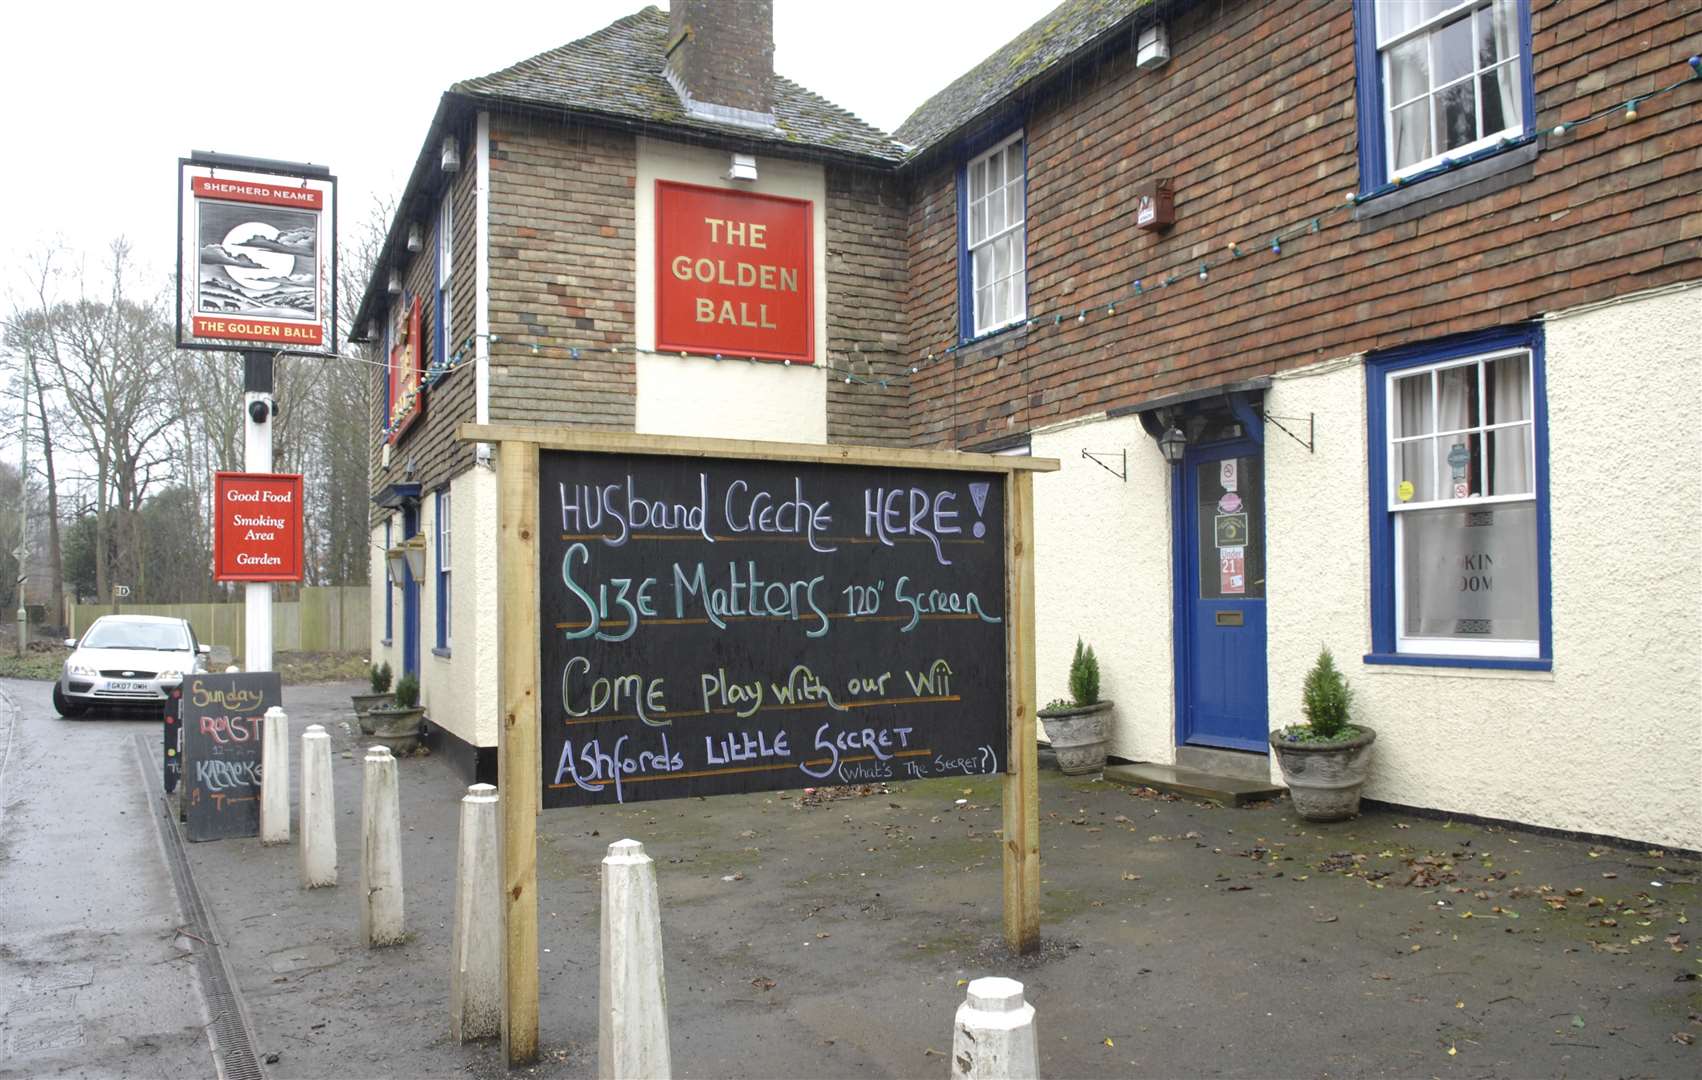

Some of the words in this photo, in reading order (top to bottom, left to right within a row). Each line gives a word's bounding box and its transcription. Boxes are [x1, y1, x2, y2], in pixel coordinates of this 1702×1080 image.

[203, 182, 270, 197] SHEPHERD
[273, 190, 315, 202] NEAME
[704, 217, 767, 249] THE
[671, 255, 798, 292] GOLDEN
[695, 297, 777, 330] BALL
[199, 321, 225, 333] THE
[228, 322, 280, 337] GOLDEN
[284, 327, 317, 339] BALL
[227, 489, 260, 502] Good
[262, 490, 292, 503] Food
[233, 514, 286, 529] Smoking
[244, 529, 275, 541] Area
[236, 552, 282, 565] Garden
[1222, 559, 1236, 573] 21
[672, 560, 830, 638] Matters
[895, 575, 1002, 632] Screen
[192, 680, 263, 712] Sunday
[701, 667, 763, 718] Play
[847, 671, 892, 697] our
[905, 658, 953, 697] Wii
[554, 732, 685, 804] Ashfords
[903, 761, 928, 780] The
